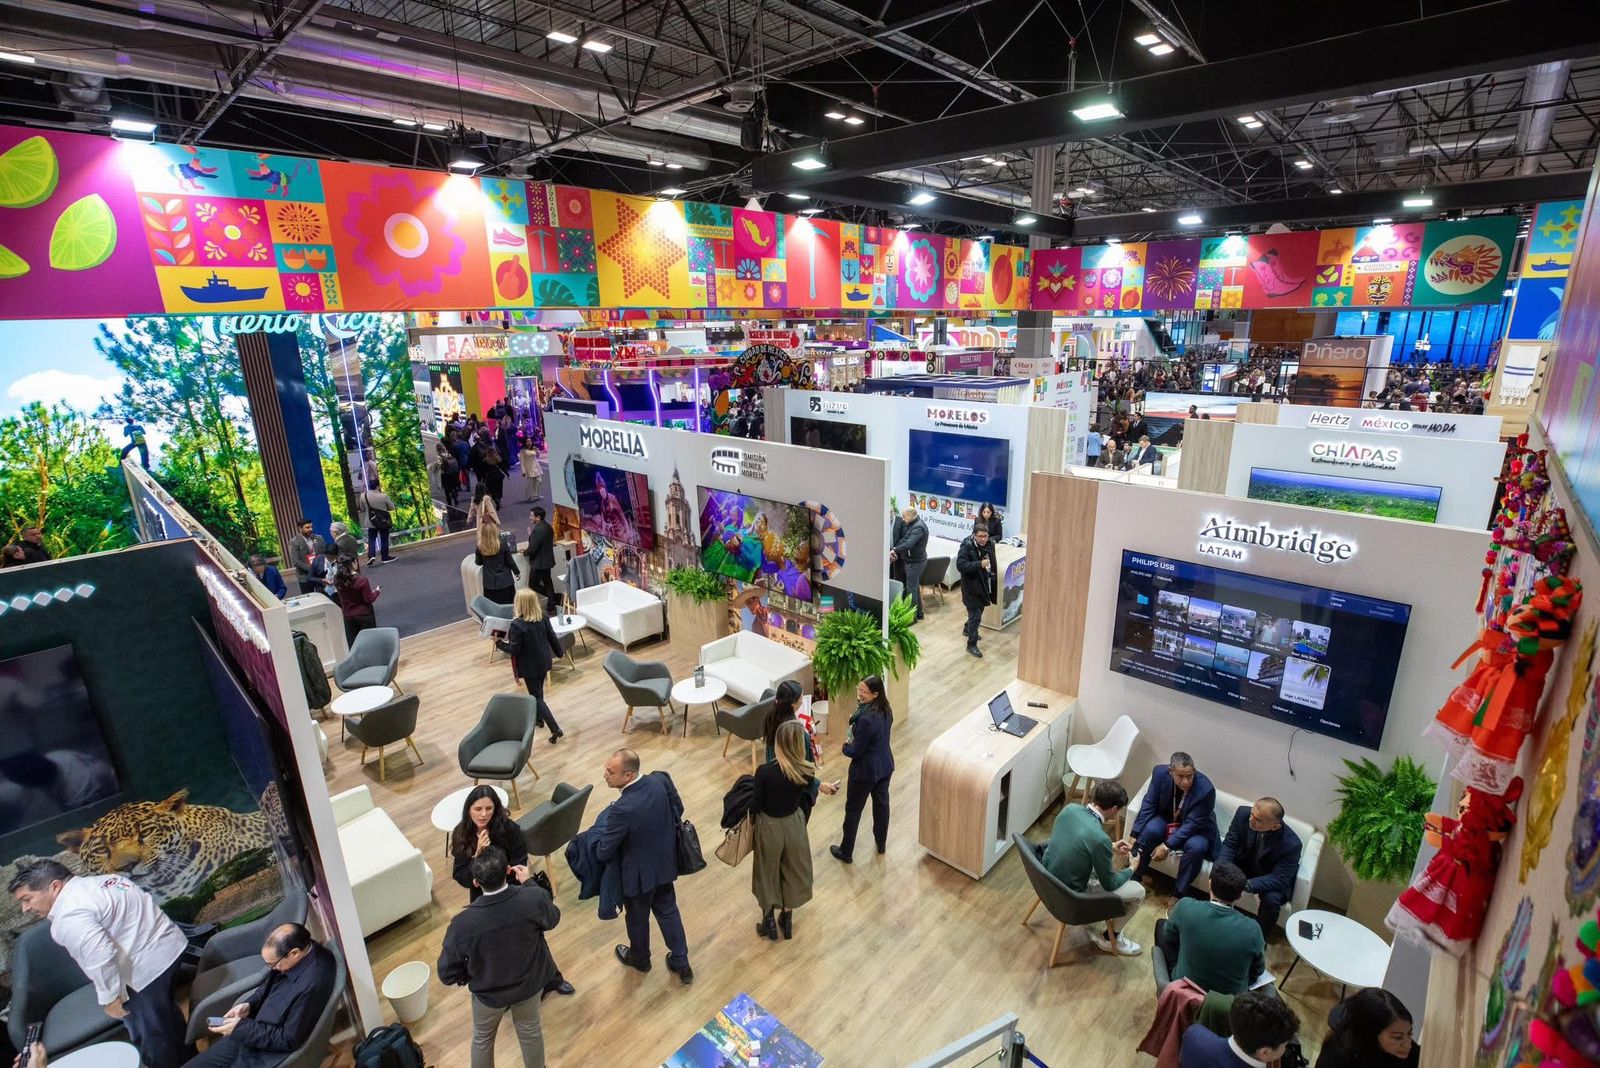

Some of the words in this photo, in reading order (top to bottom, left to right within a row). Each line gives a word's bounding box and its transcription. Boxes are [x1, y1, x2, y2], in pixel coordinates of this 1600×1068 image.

[1303, 342, 1367, 360] Piñero
[927, 408, 987, 423] MORELOS
[1310, 413, 1350, 426] Hertz
[579, 425, 645, 457] MORELIA
[1312, 442, 1398, 462] CHIAPAS
[909, 492, 1004, 522] MOREL
[1200, 517, 1352, 563] Aimbridge
[1199, 543, 1242, 560] LATAM
[1131, 556, 1159, 568] PHILIPS
[1159, 562, 1175, 571] USB
